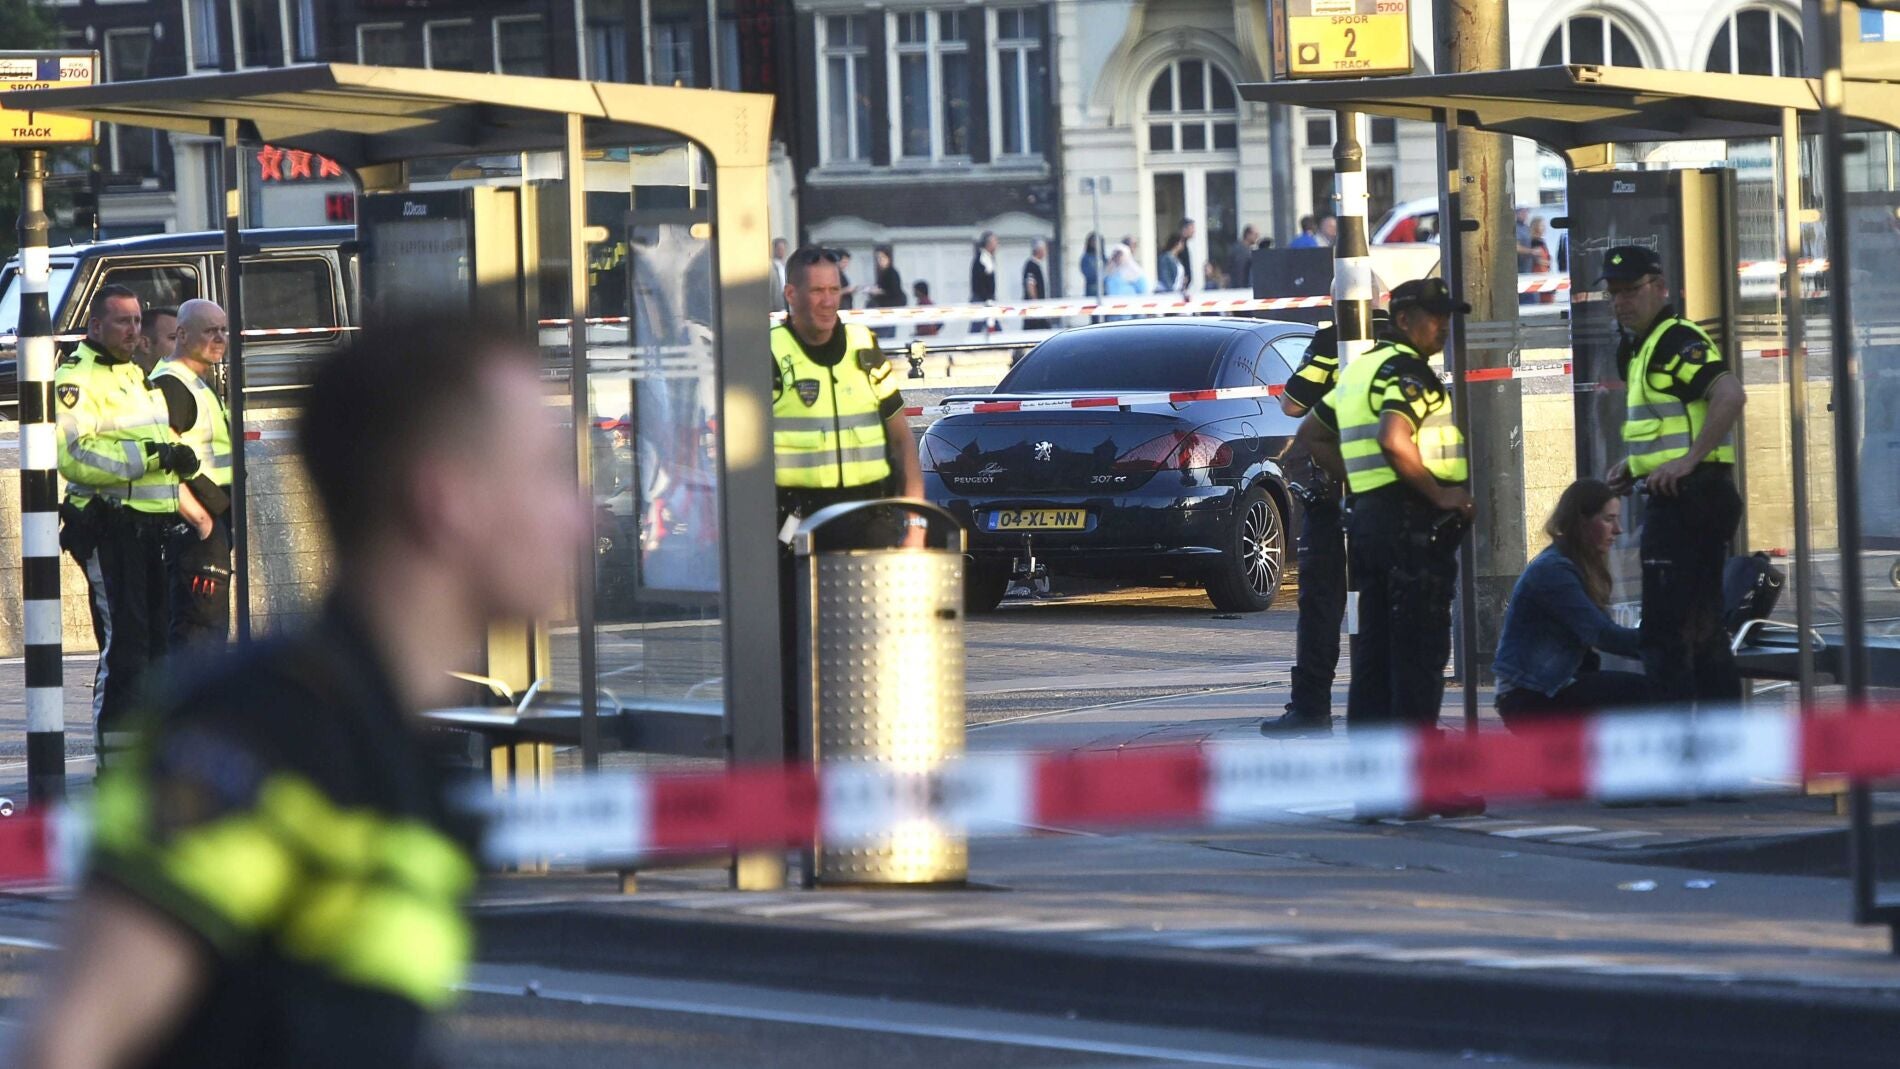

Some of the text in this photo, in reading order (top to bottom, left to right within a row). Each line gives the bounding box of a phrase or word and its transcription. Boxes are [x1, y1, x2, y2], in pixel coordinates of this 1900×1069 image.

[1377, 2, 1405, 12] 5700
[1331, 15, 1369, 24] SPOOR
[1344, 28, 1357, 57] 2
[1334, 60, 1371, 69] TRACK
[60, 68, 89, 78] 5700
[12, 128, 51, 137] TRACK
[954, 476, 995, 484] PEUGEOT
[1000, 511, 1079, 527] 04-XL-NN
